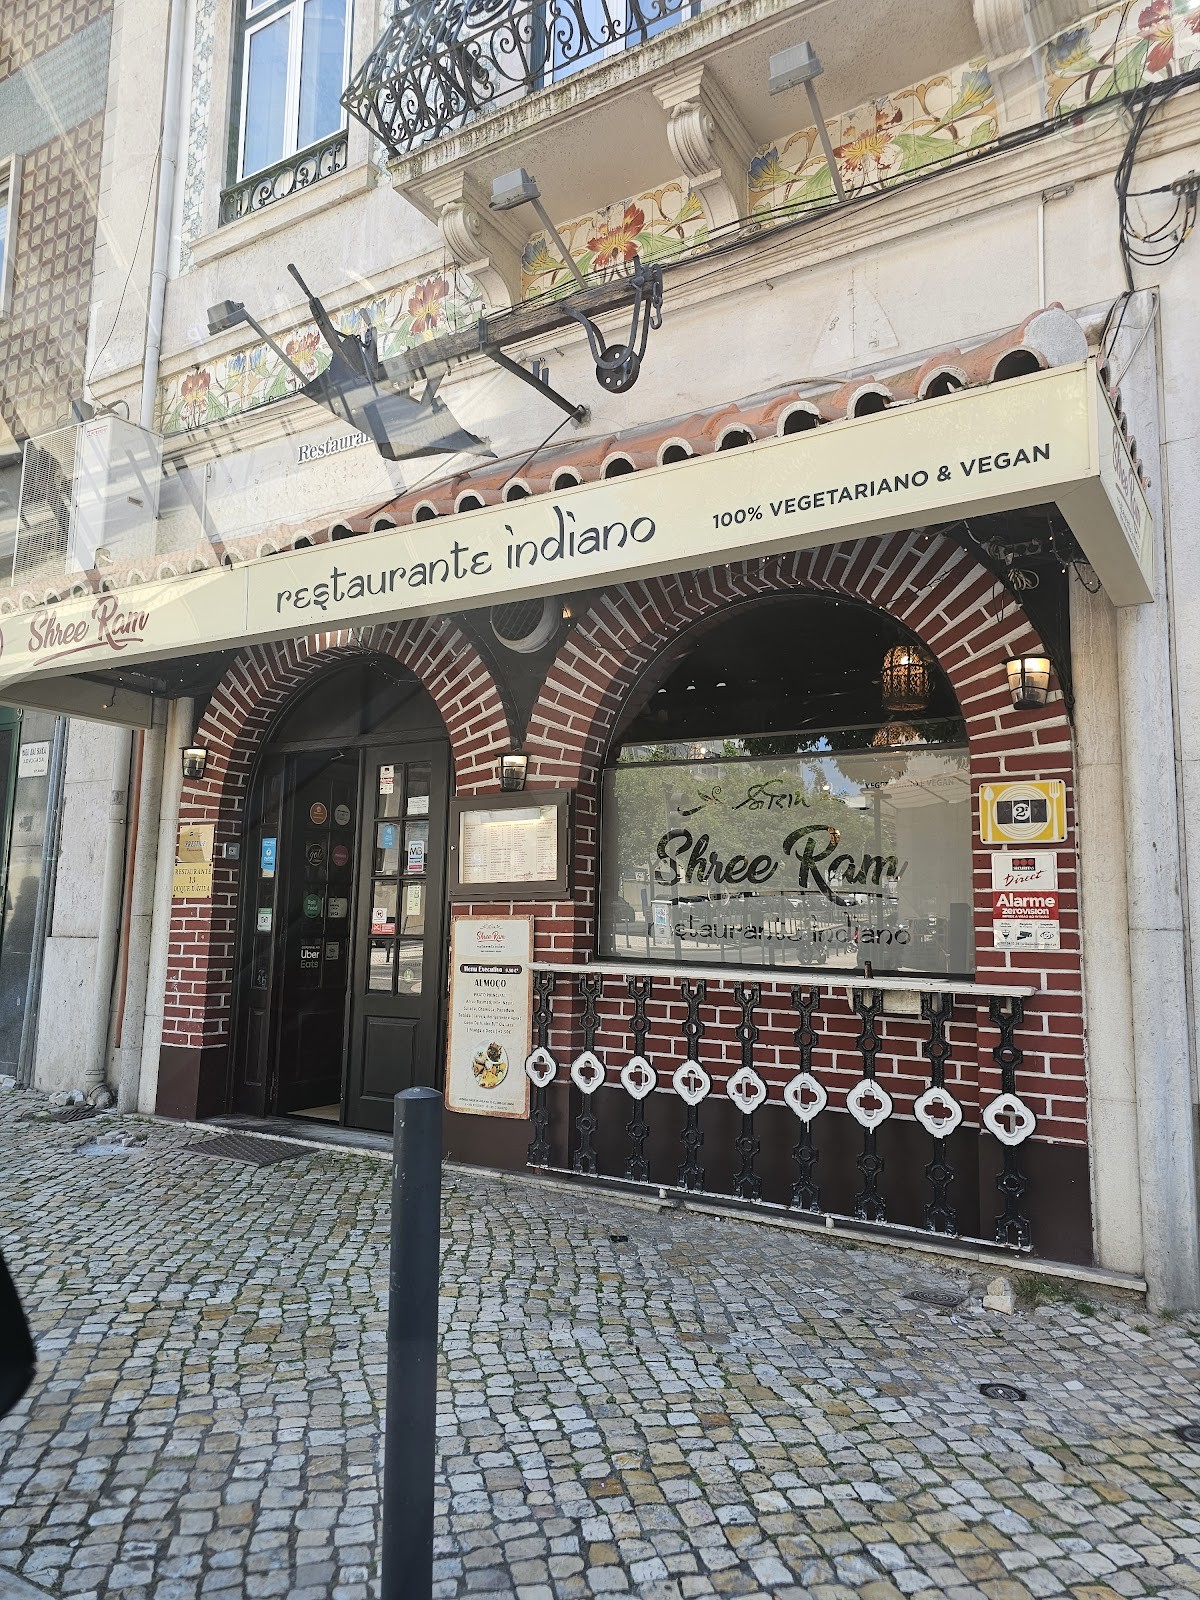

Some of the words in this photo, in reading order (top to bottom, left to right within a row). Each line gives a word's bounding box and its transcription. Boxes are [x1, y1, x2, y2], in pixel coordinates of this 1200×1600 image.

[712, 504, 763, 529] 100%
[769, 470, 929, 518] VEGETARIANO
[936, 465, 952, 482] &
[960, 443, 1051, 477] VEGAN
[275, 540, 493, 613] restaurante
[504, 505, 656, 570] indiano
[28, 611, 90, 652] Shree
[91, 595, 150, 650] Ram
[409, 847, 423, 856] MB
[655, 827, 779, 887] Shree
[782, 824, 908, 907] Ram
[1003, 870, 1046, 887] Direct
[996, 893, 1056, 908] Alarme
[300, 950, 320, 959] Uber
[300, 959, 319, 969] Eats
